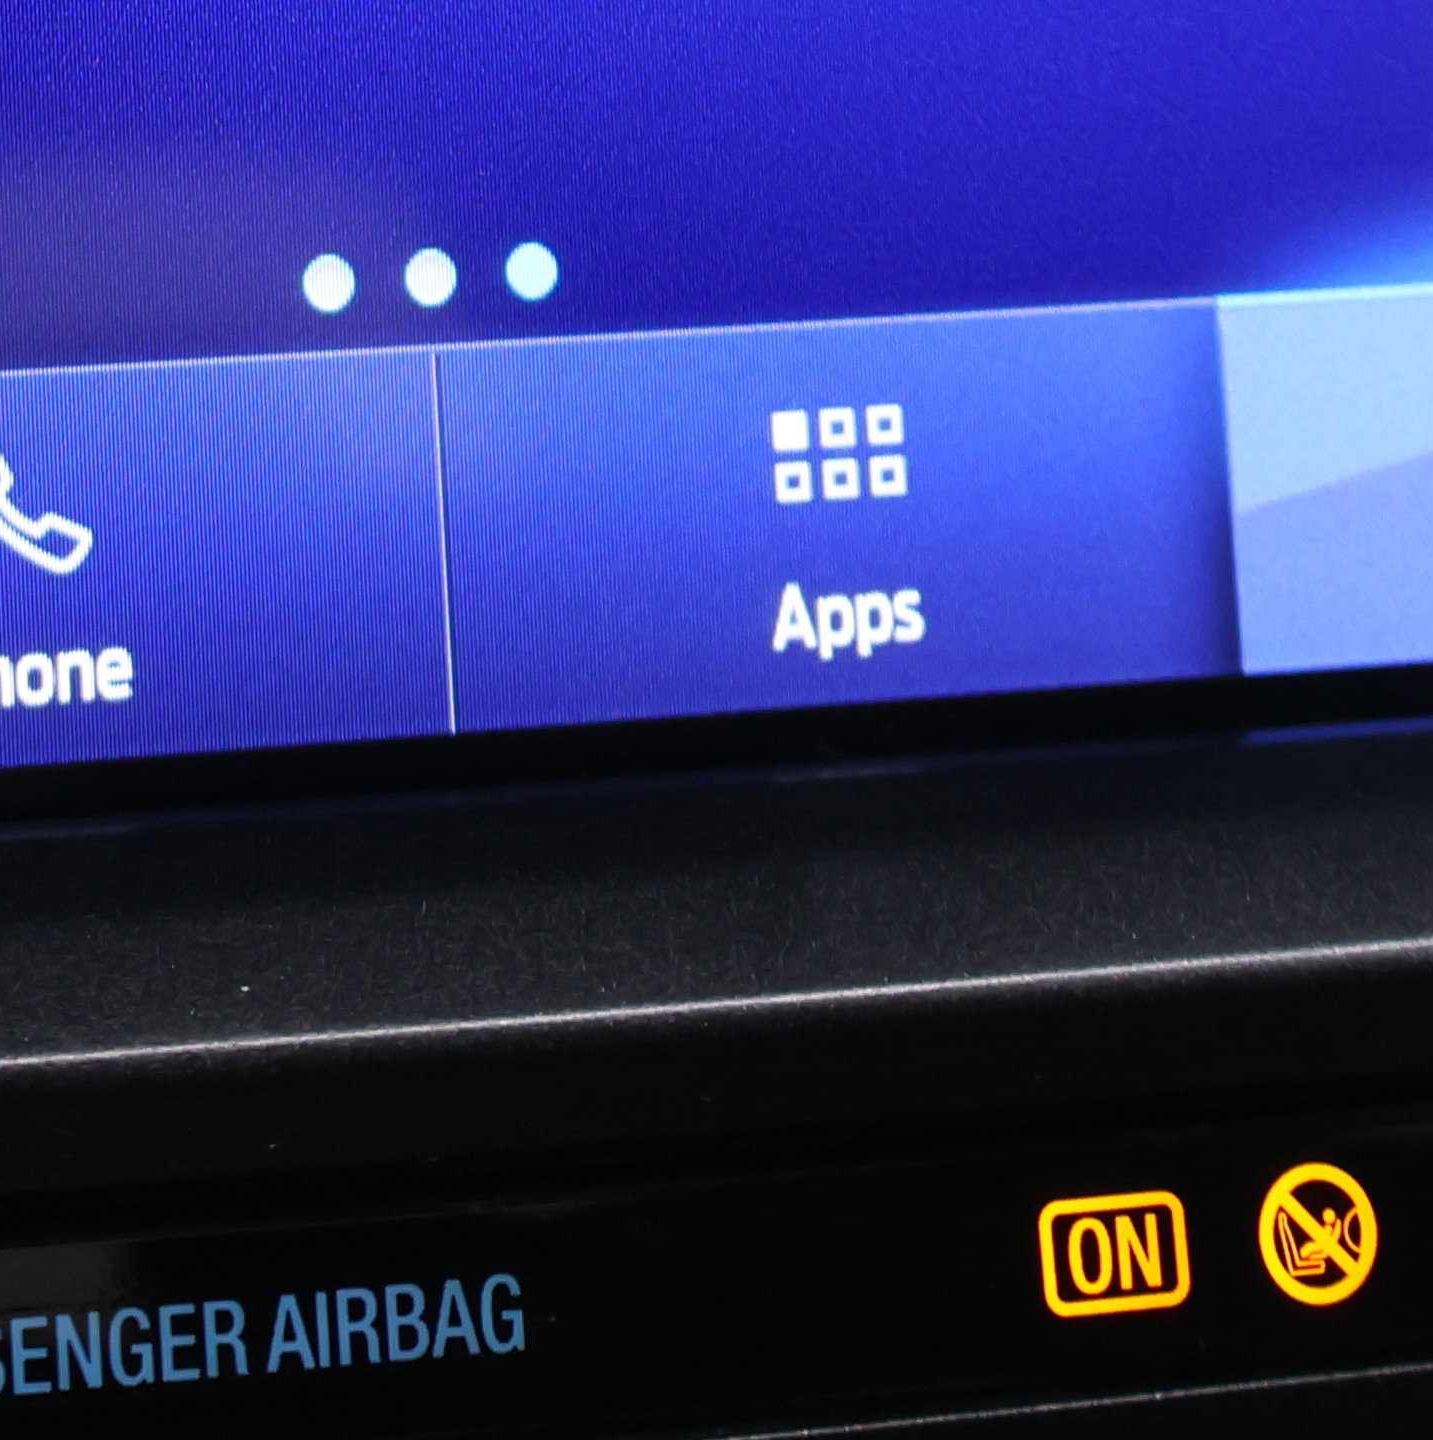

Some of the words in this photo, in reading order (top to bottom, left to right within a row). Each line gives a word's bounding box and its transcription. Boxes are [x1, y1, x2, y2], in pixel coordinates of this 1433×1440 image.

[771, 580, 927, 662] Apps
[1067, 1212, 1164, 1296] ON
[265, 1273, 527, 1374] AIRBAG
